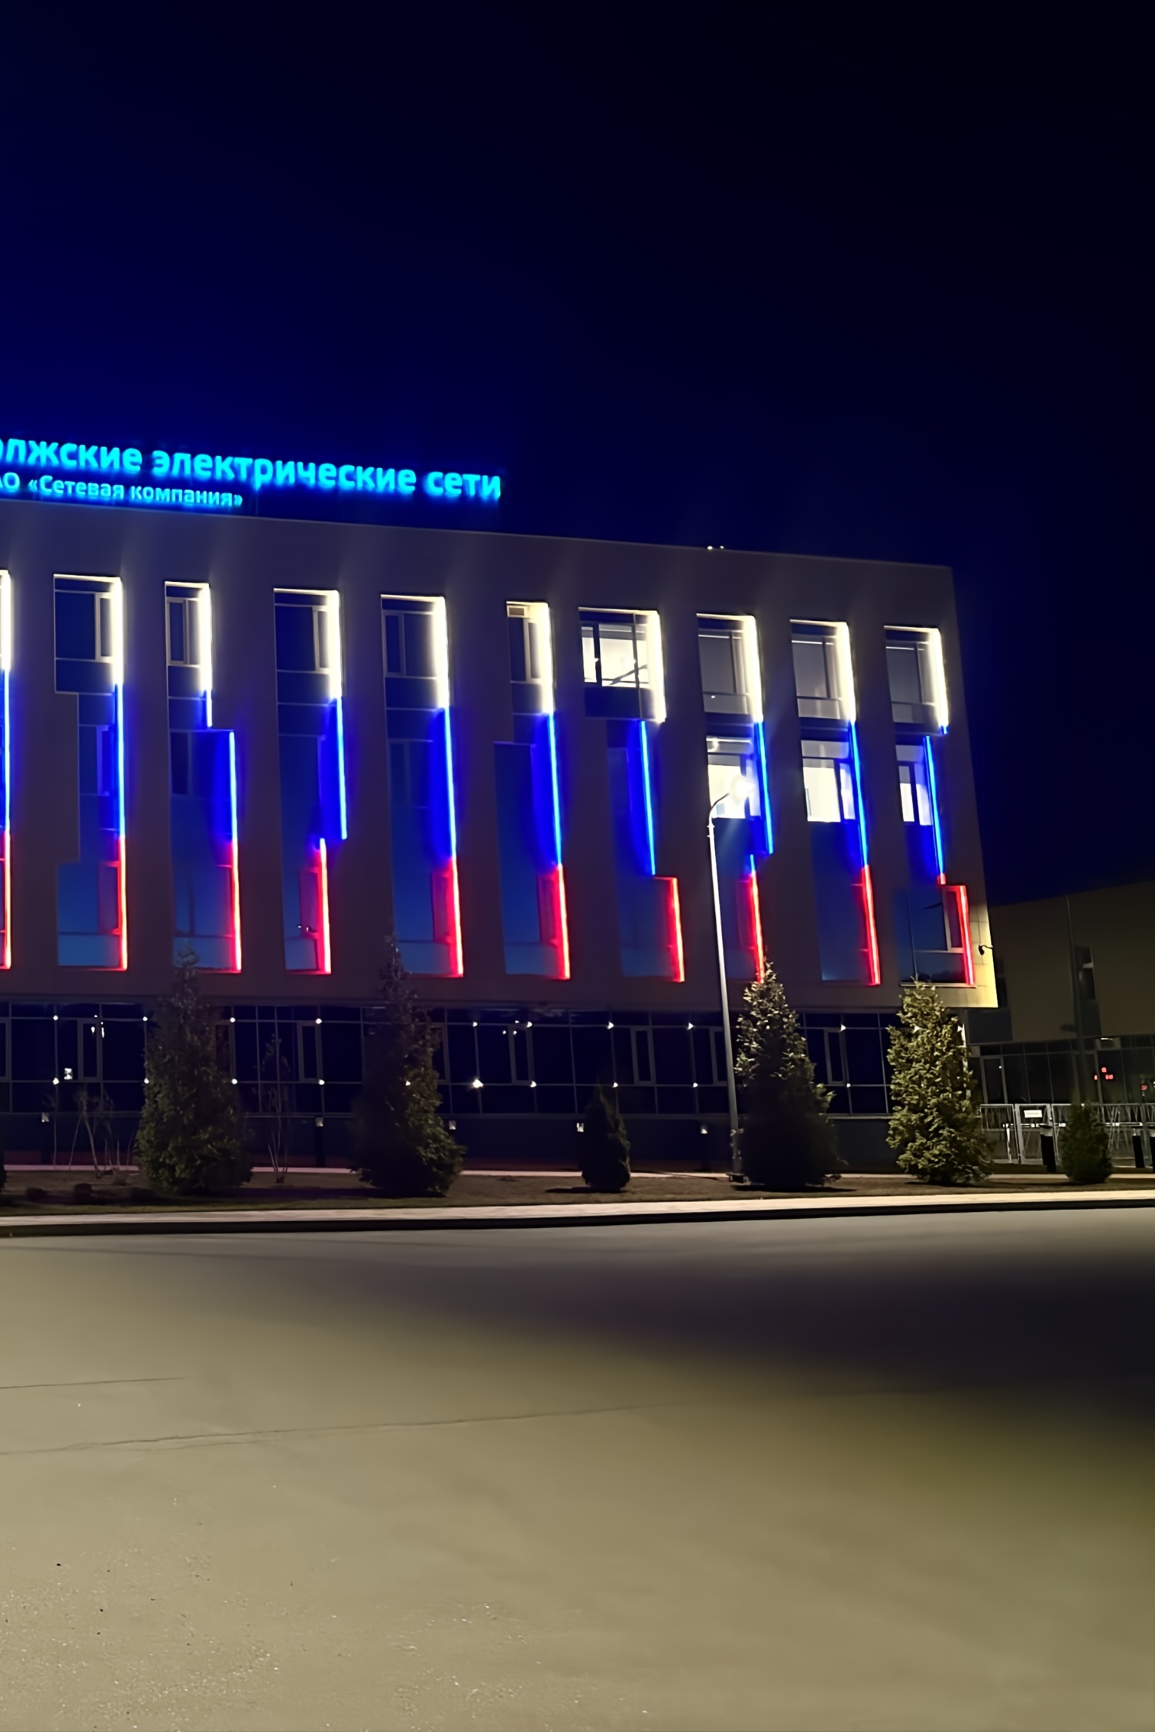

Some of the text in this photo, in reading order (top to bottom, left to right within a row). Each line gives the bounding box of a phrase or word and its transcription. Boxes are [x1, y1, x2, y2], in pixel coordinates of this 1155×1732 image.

[27, 474, 125, 503] «Сетевая
[129, 484, 243, 508] компания»
[151, 449, 417, 495] электрические
[424, 470, 502, 501] сети
